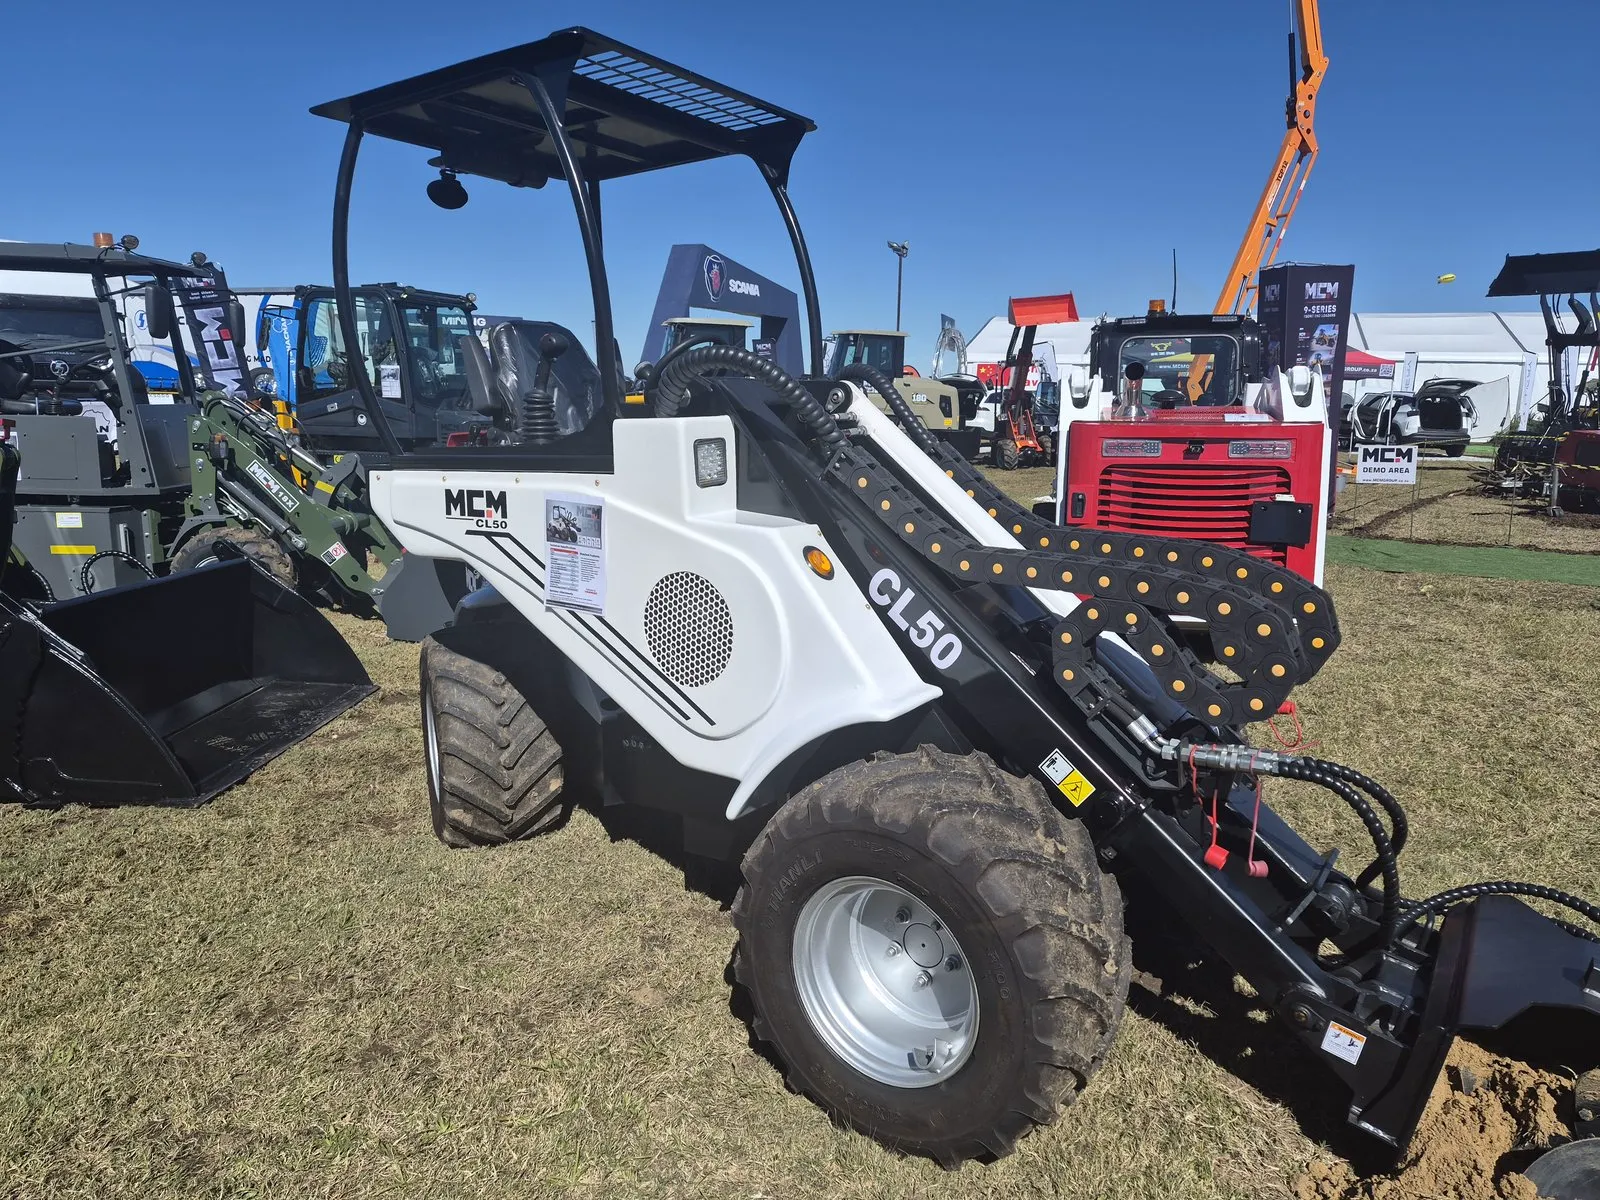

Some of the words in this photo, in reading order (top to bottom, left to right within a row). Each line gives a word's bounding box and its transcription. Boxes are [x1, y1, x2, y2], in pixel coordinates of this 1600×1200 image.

[729, 279, 760, 296] SCANIA
[1305, 282, 1339, 299] MCM
[1304, 305, 1337, 314] 9-SERIES
[1362, 447, 1413, 462] MCM
[249, 462, 280, 494] MCM
[276, 491, 295, 508] 18X
[445, 489, 507, 519] MCM
[476, 519, 508, 529] CL50
[868, 568, 963, 670] CL50
[767, 850, 824, 912] TIANLI
